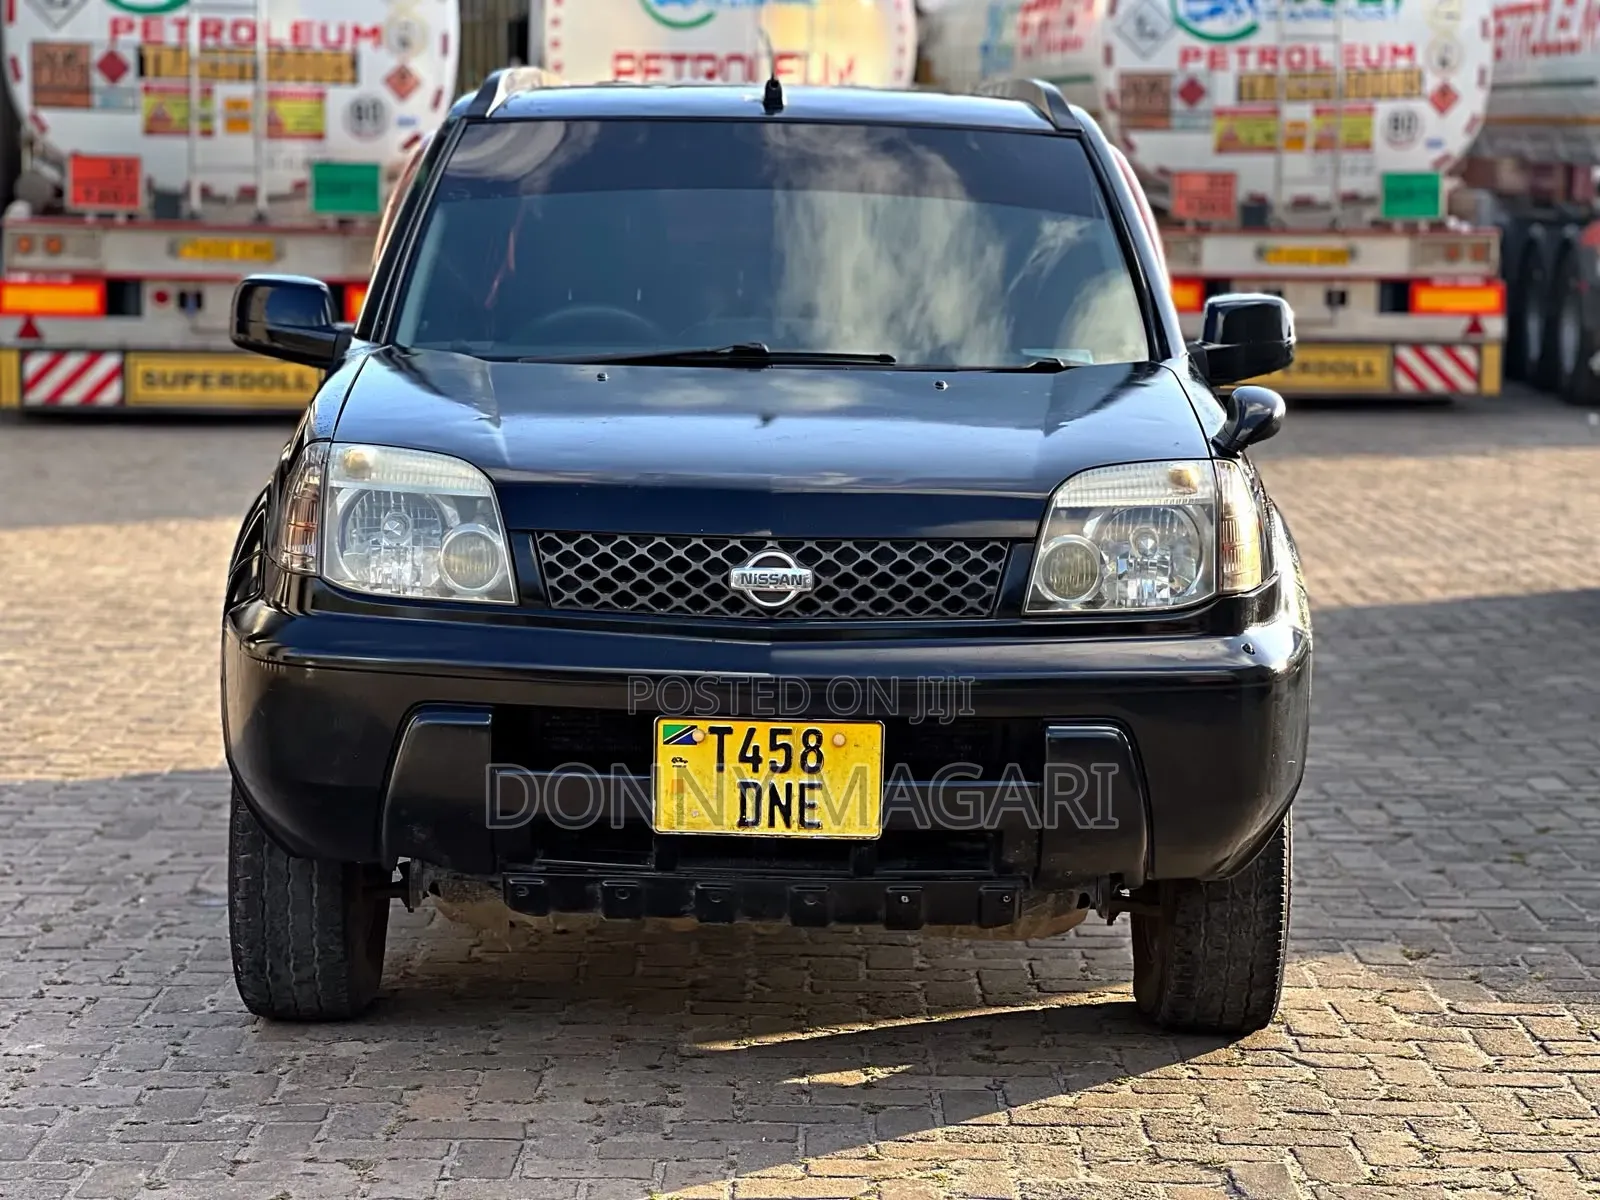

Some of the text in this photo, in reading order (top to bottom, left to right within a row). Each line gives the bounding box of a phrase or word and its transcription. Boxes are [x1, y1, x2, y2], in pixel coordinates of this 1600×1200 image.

[109, 17, 383, 48] PETROLEUM
[1179, 42, 1416, 72] PETROLEUM
[143, 370, 313, 393] SUPERDOLL
[740, 572, 803, 586] NISSAN
[708, 725, 824, 774] T458
[737, 780, 823, 830] DNE
